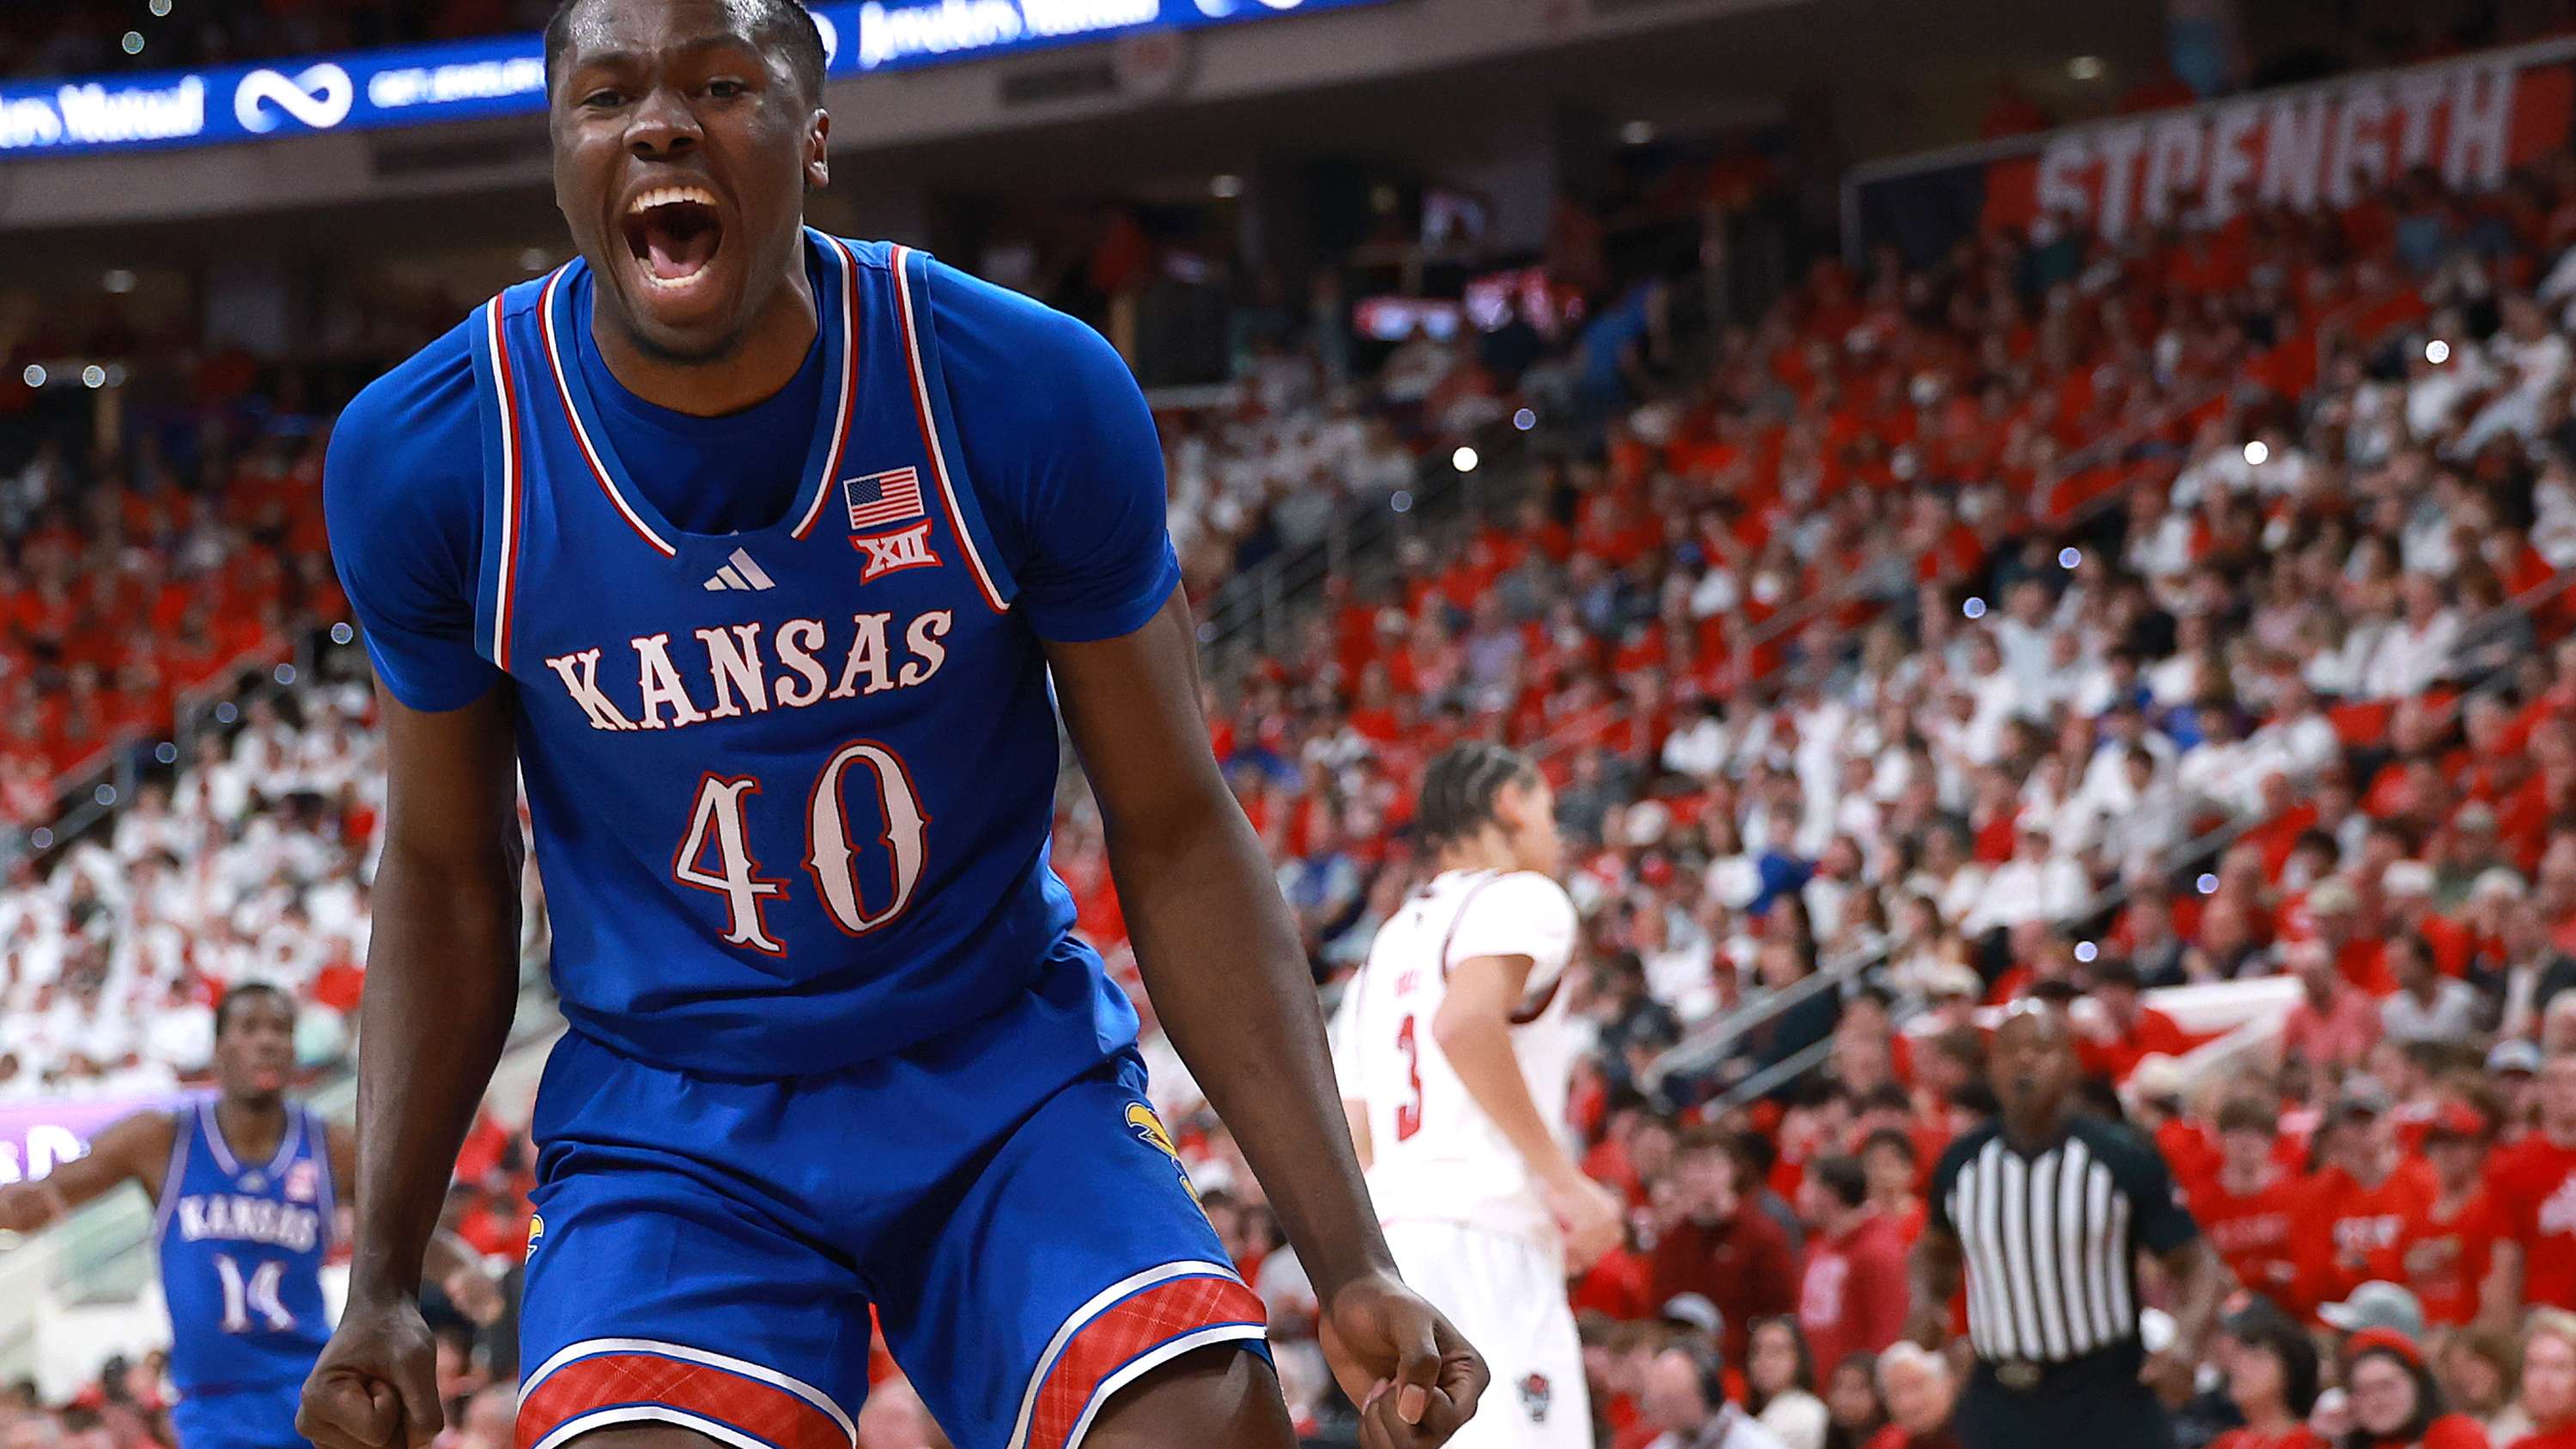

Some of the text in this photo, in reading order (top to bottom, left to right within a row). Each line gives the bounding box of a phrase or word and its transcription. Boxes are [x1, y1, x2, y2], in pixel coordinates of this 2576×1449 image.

[546, 609, 955, 731] KANSAS
[673, 740, 933, 956] 40
[1395, 1013, 1423, 1143] 3
[179, 1194, 319, 1253] KANSAS
